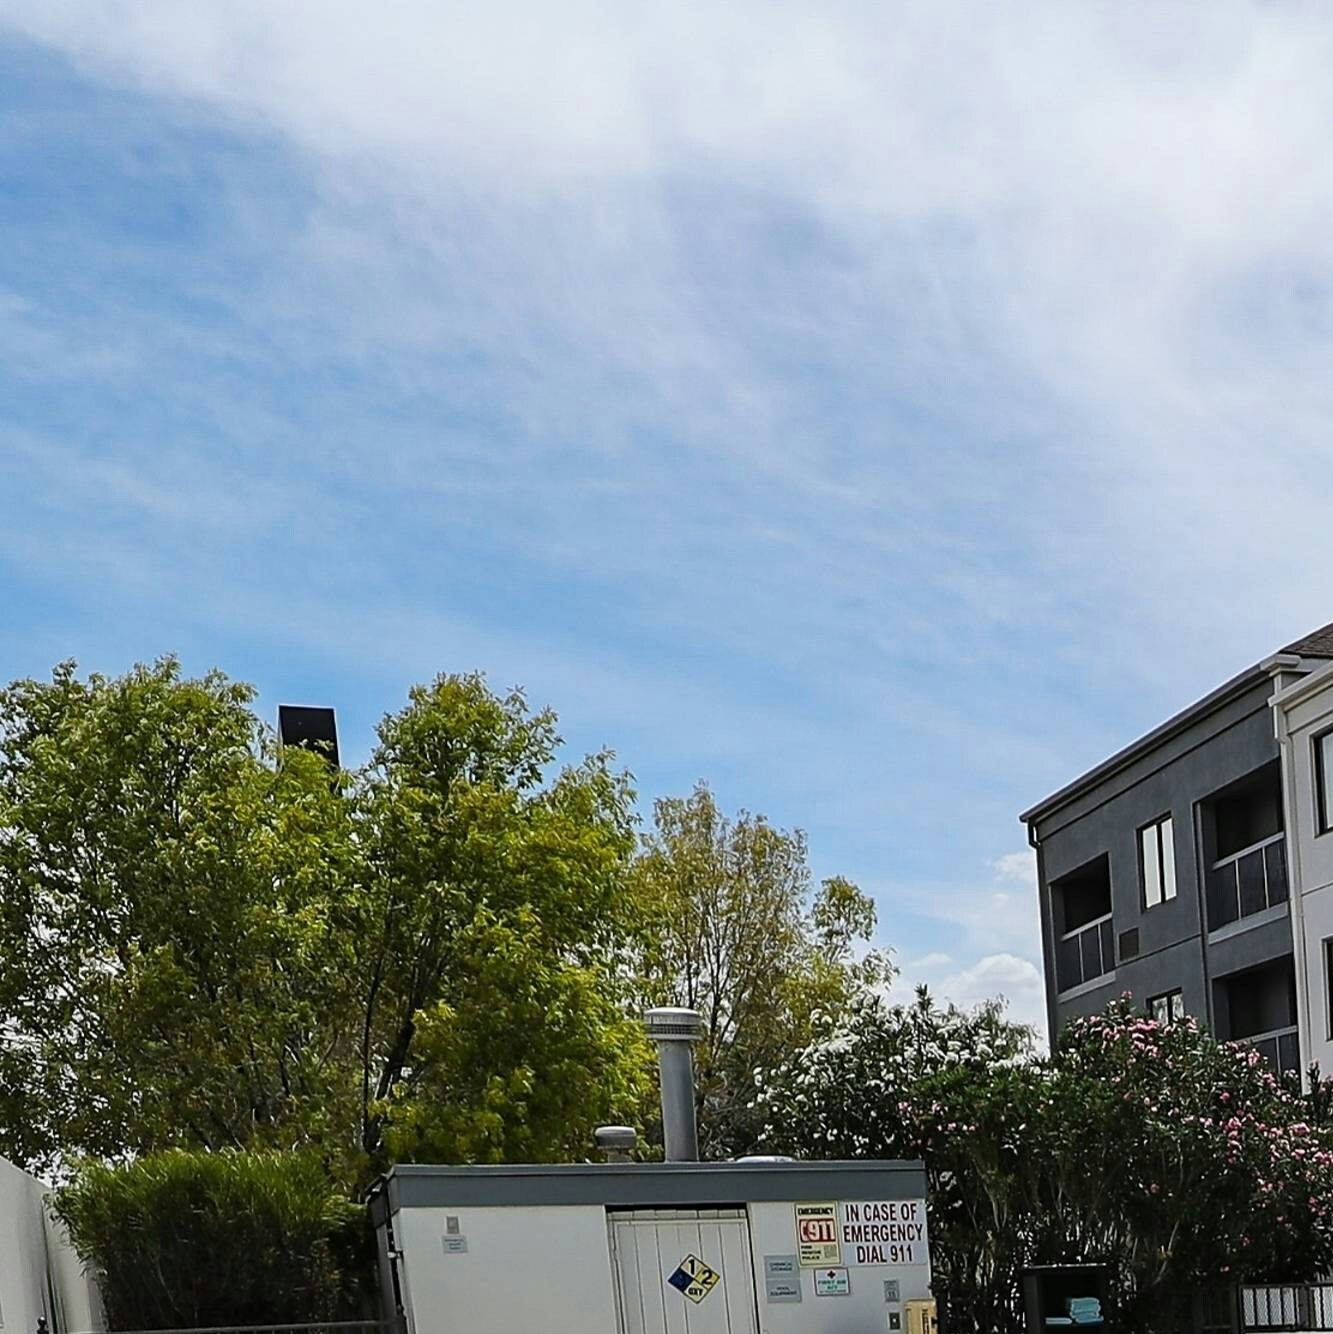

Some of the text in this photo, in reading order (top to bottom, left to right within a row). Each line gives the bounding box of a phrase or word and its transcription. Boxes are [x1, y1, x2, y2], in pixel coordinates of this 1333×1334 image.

[799, 1207, 834, 1216] EMERGENCY
[846, 1203, 917, 1221] IN CASE OF
[809, 1220, 836, 1241] 911
[843, 1223, 923, 1243] EMERGENCY
[857, 1244, 913, 1264] DIAL 911
[688, 1259, 695, 1275] 1
[701, 1270, 713, 1285] 2
